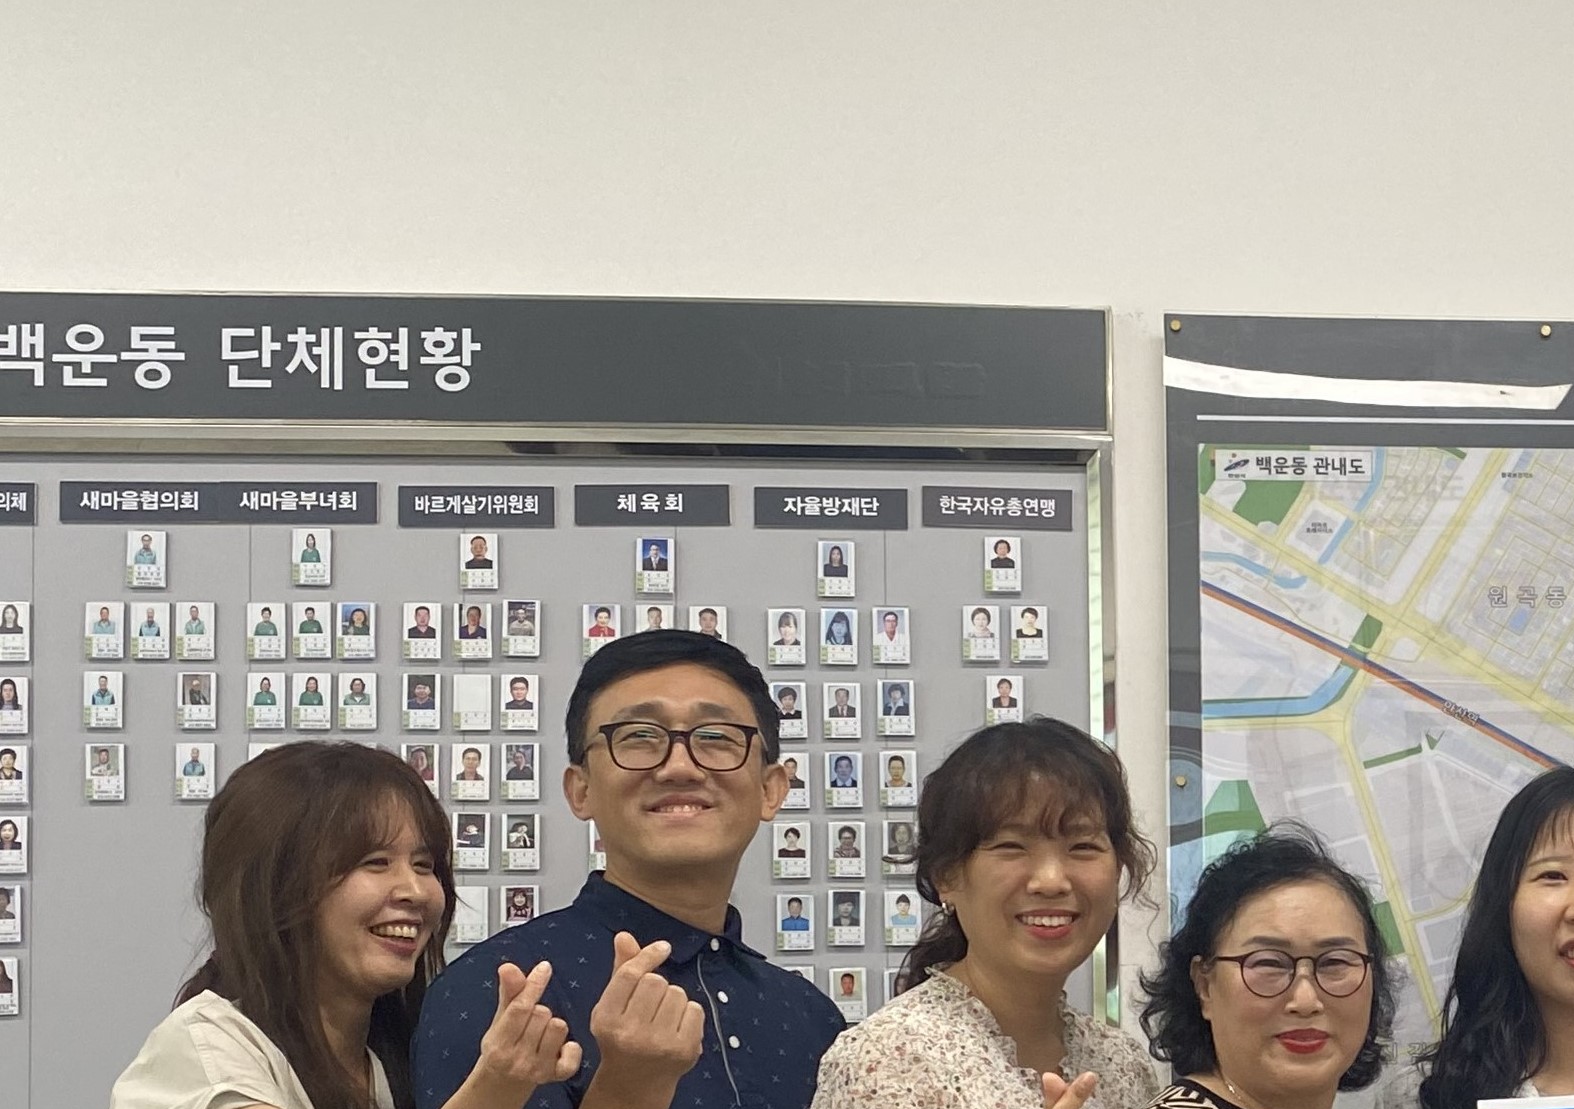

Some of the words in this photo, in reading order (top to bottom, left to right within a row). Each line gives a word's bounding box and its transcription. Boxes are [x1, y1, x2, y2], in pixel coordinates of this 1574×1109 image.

[0, 323, 186, 390] 백운동
[221, 325, 482, 392] 단체현황
[1255, 456, 1308, 475] 백운동
[1312, 457, 1367, 475] 관내도
[79, 490, 199, 511] 새마을협의회
[239, 490, 357, 511] 새마을부녀회
[414, 494, 539, 515] 바르게살기위원회
[616, 493, 683, 513] 체육회
[783, 495, 880, 517] 자율방재단
[939, 495, 1056, 518] 한국자유총연맹
[1487, 586, 1566, 608] 원곡동
